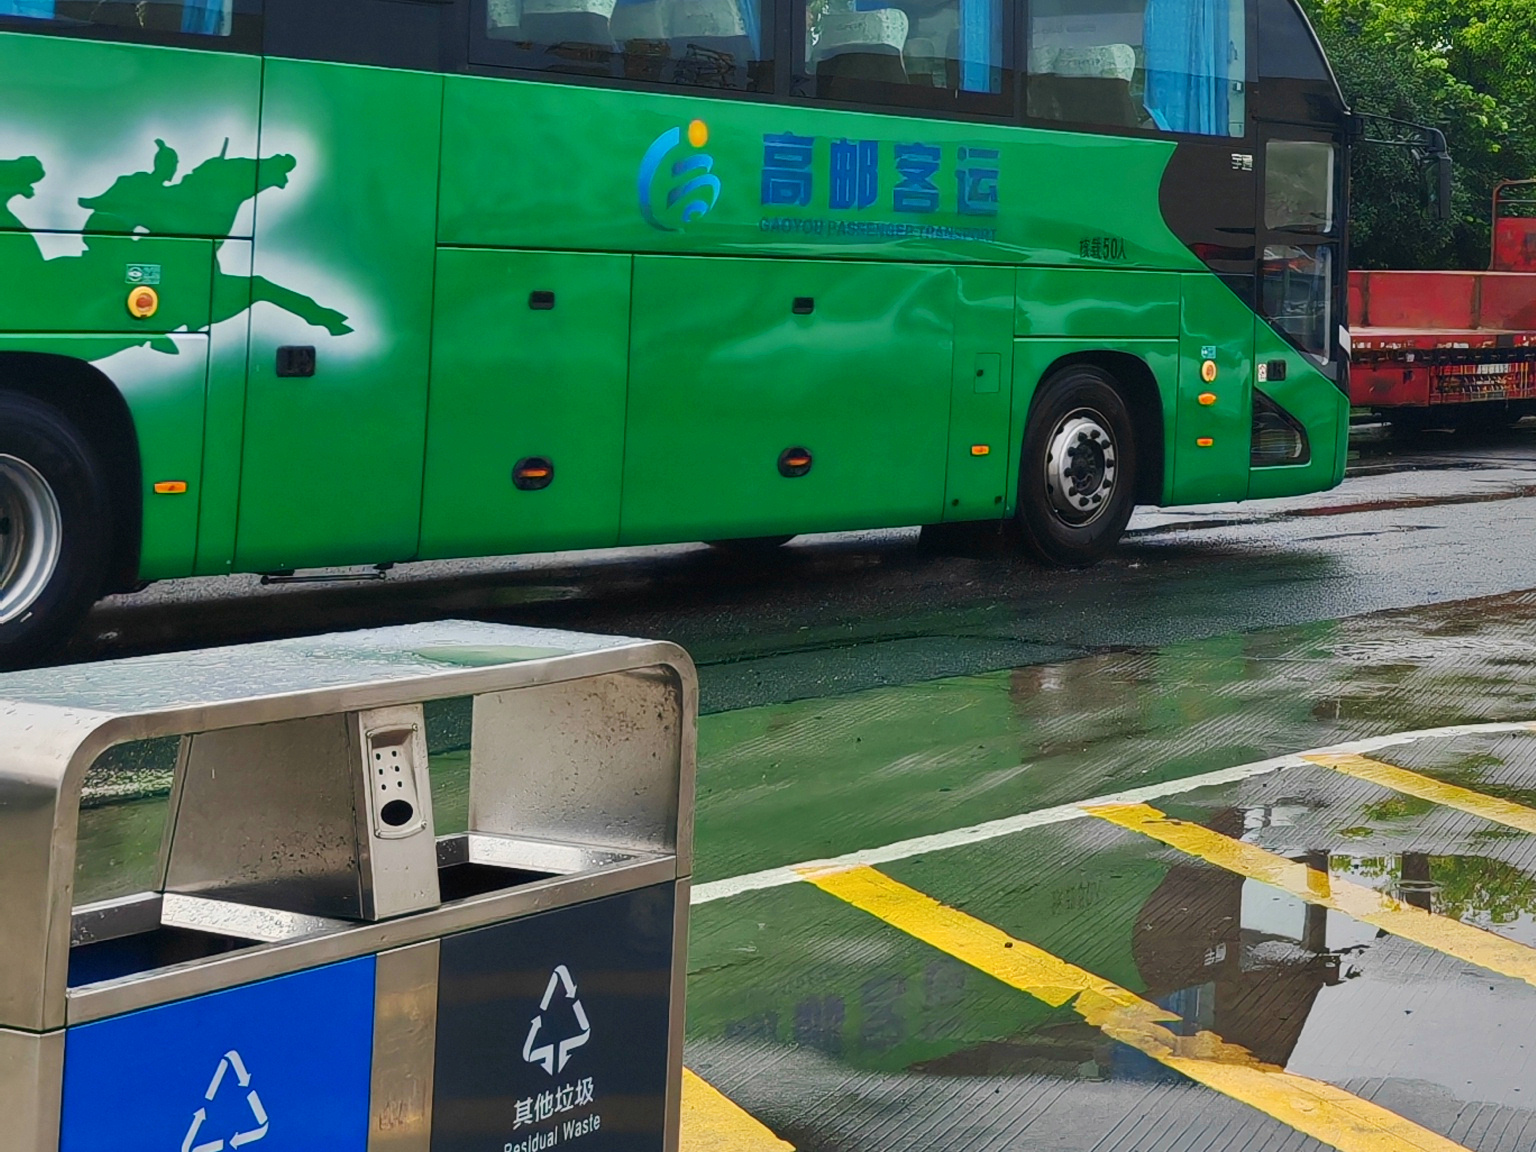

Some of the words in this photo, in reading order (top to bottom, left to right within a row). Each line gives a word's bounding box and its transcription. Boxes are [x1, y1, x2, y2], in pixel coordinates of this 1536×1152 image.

[761, 131, 1000, 215] 高邮客运
[512, 1076, 594, 1130] 其他垃圾
[563, 1113, 601, 1141] Waste
